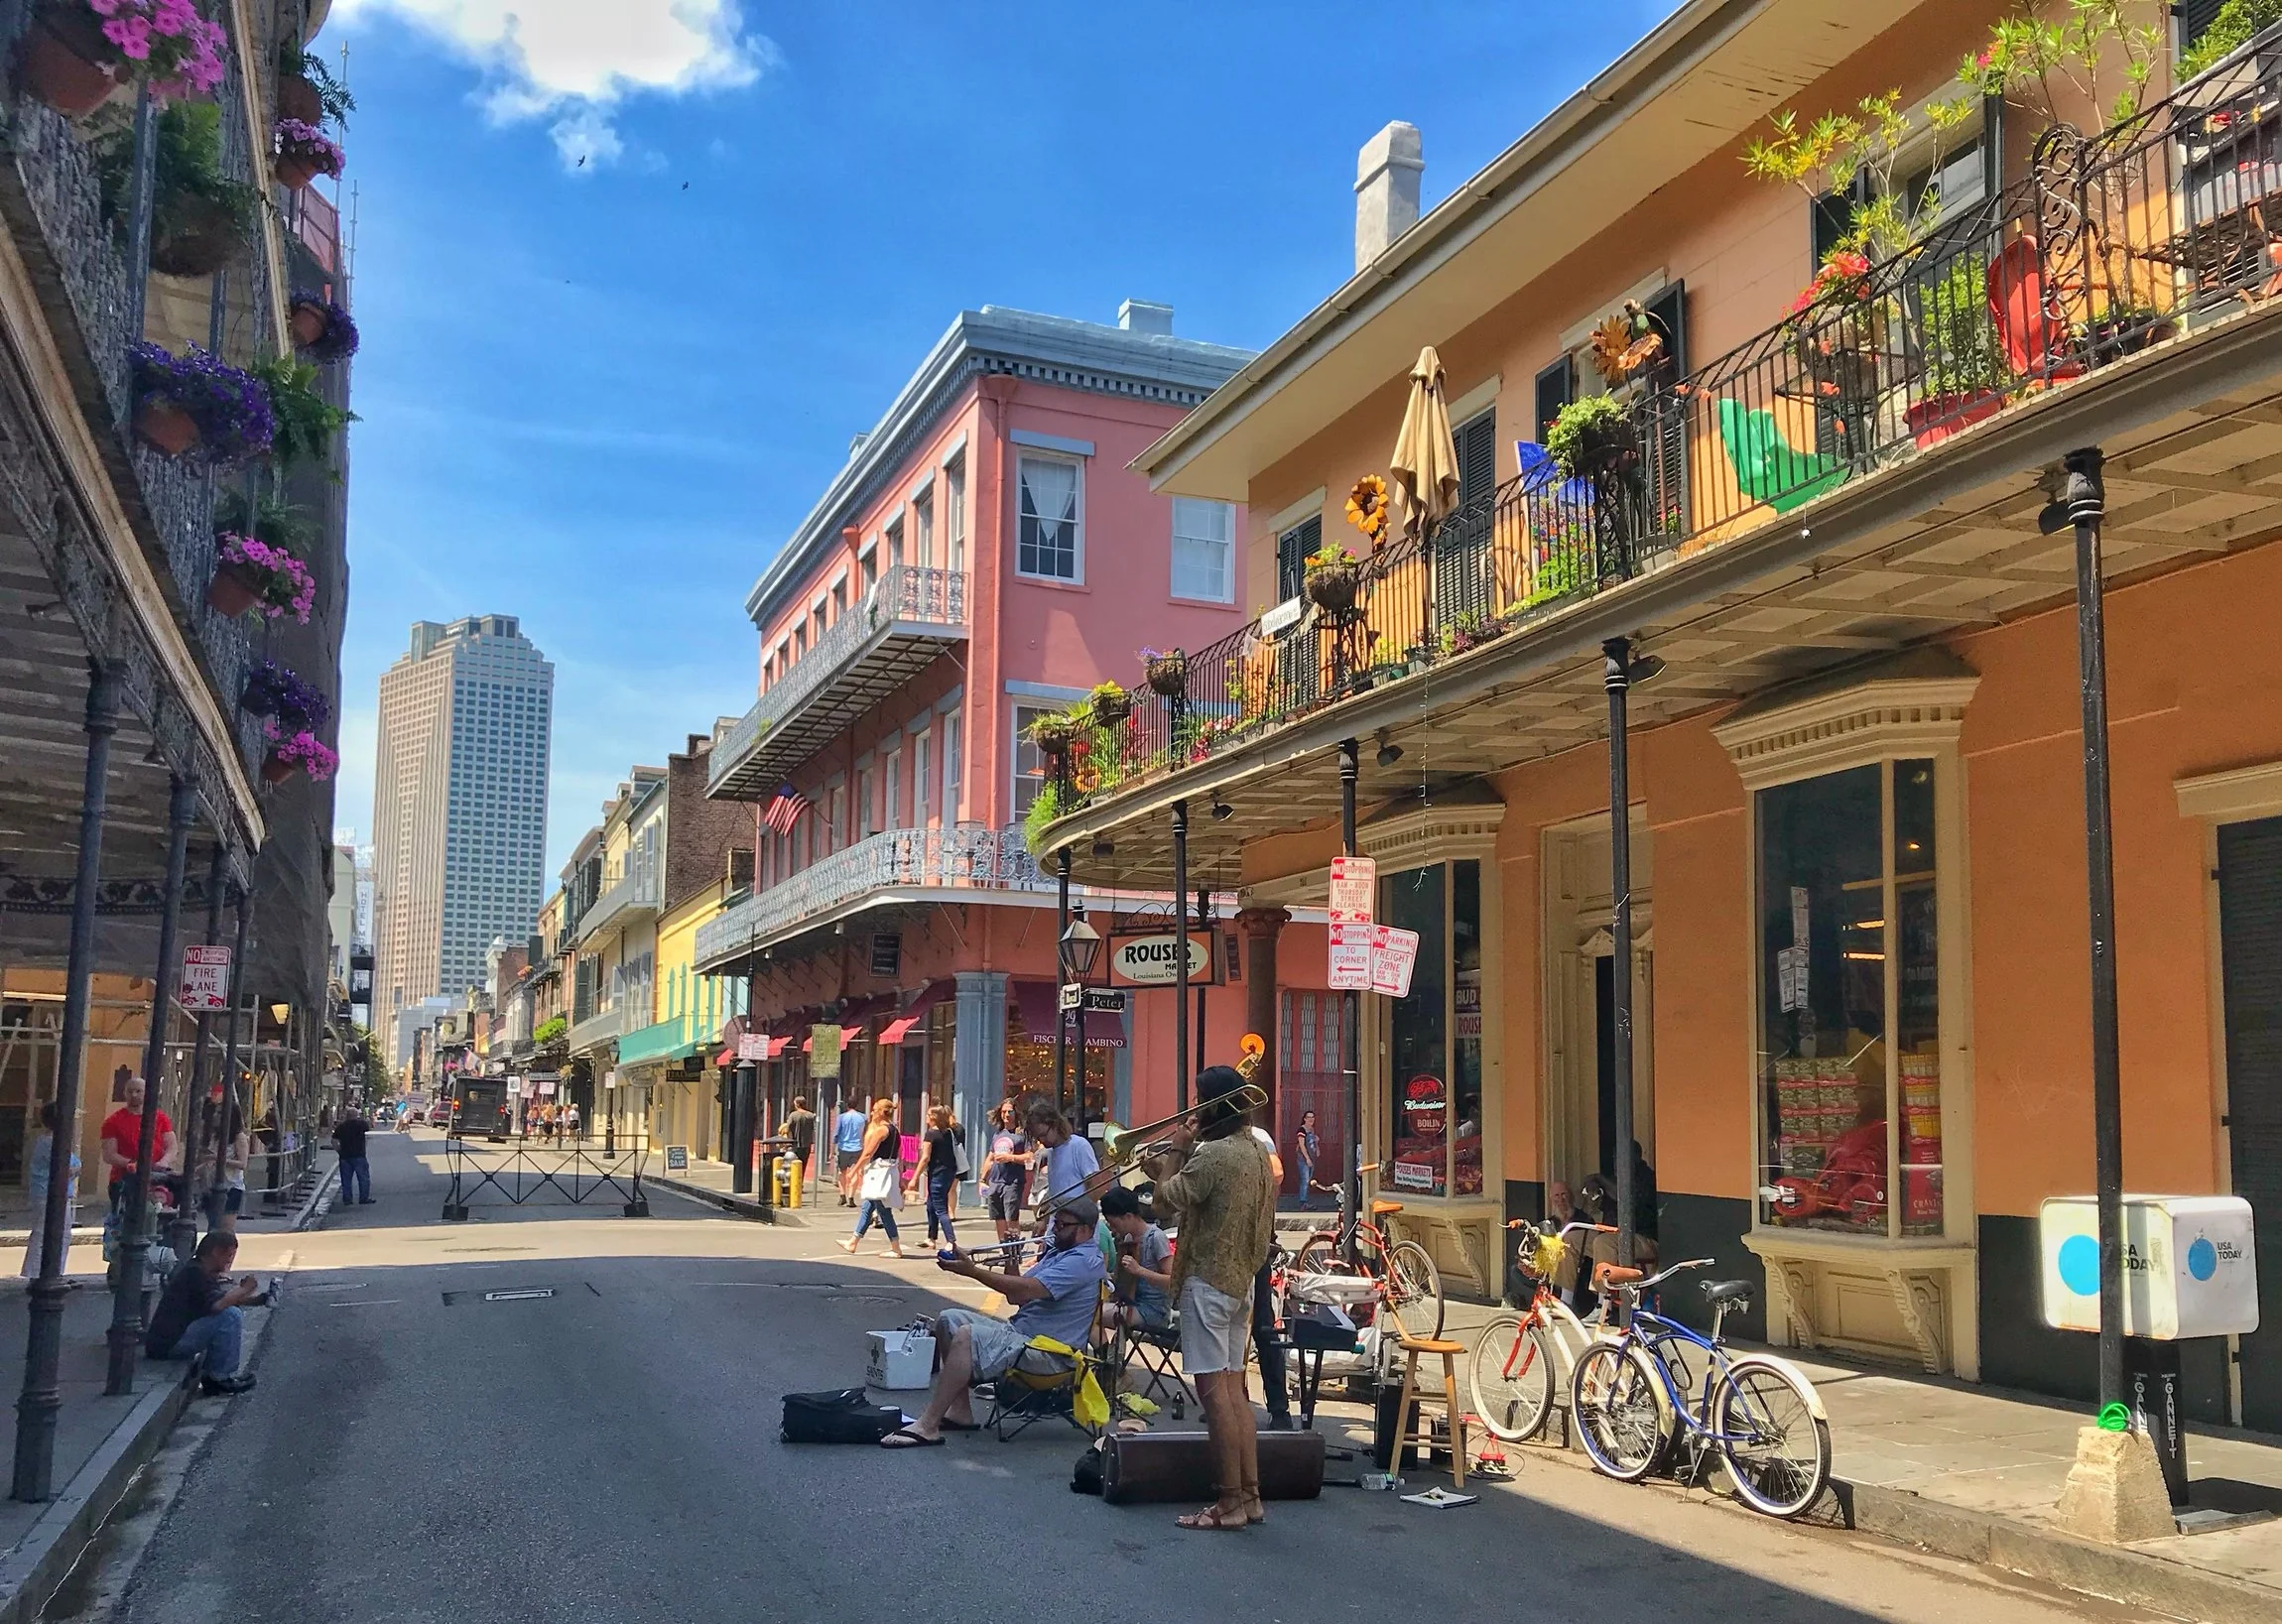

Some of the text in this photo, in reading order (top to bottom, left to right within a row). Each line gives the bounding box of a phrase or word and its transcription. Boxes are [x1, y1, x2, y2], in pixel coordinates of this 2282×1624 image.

[1332, 863, 1344, 874] NO
[1331, 928, 1370, 942] NO STOPPING
[1373, 932, 1415, 947] NO PARKING
[187, 949, 200, 961] NO
[1333, 955, 1367, 964] CORNER
[1375, 949, 1410, 963] FREIGHT
[1165, 961, 1198, 970] MAET
[1379, 960, 1401, 972] ZONE
[193, 967, 217, 978] FIRE
[1332, 975, 1368, 984] ANYTIME
[191, 981, 217, 992] LANE
[1091, 996, 1123, 1008] Peter
[1456, 989, 1476, 1005] BUD
[1458, 1017, 1481, 1035] ROUS
[1033, 1035, 1123, 1048] FISCHR AMBINO
[1404, 1099, 1446, 1111] Budweiser
[1396, 1164, 1411, 1176] ROUSES
[2120, 1243, 2138, 1257] SA
[2217, 1242, 2232, 1251] USA
[2218, 1250, 2242, 1260] TODAY
[2120, 1258, 2156, 1271] ODAY
[2134, 1381, 2148, 1433] GANNE
[2165, 1382, 2178, 1459] GANNETT
